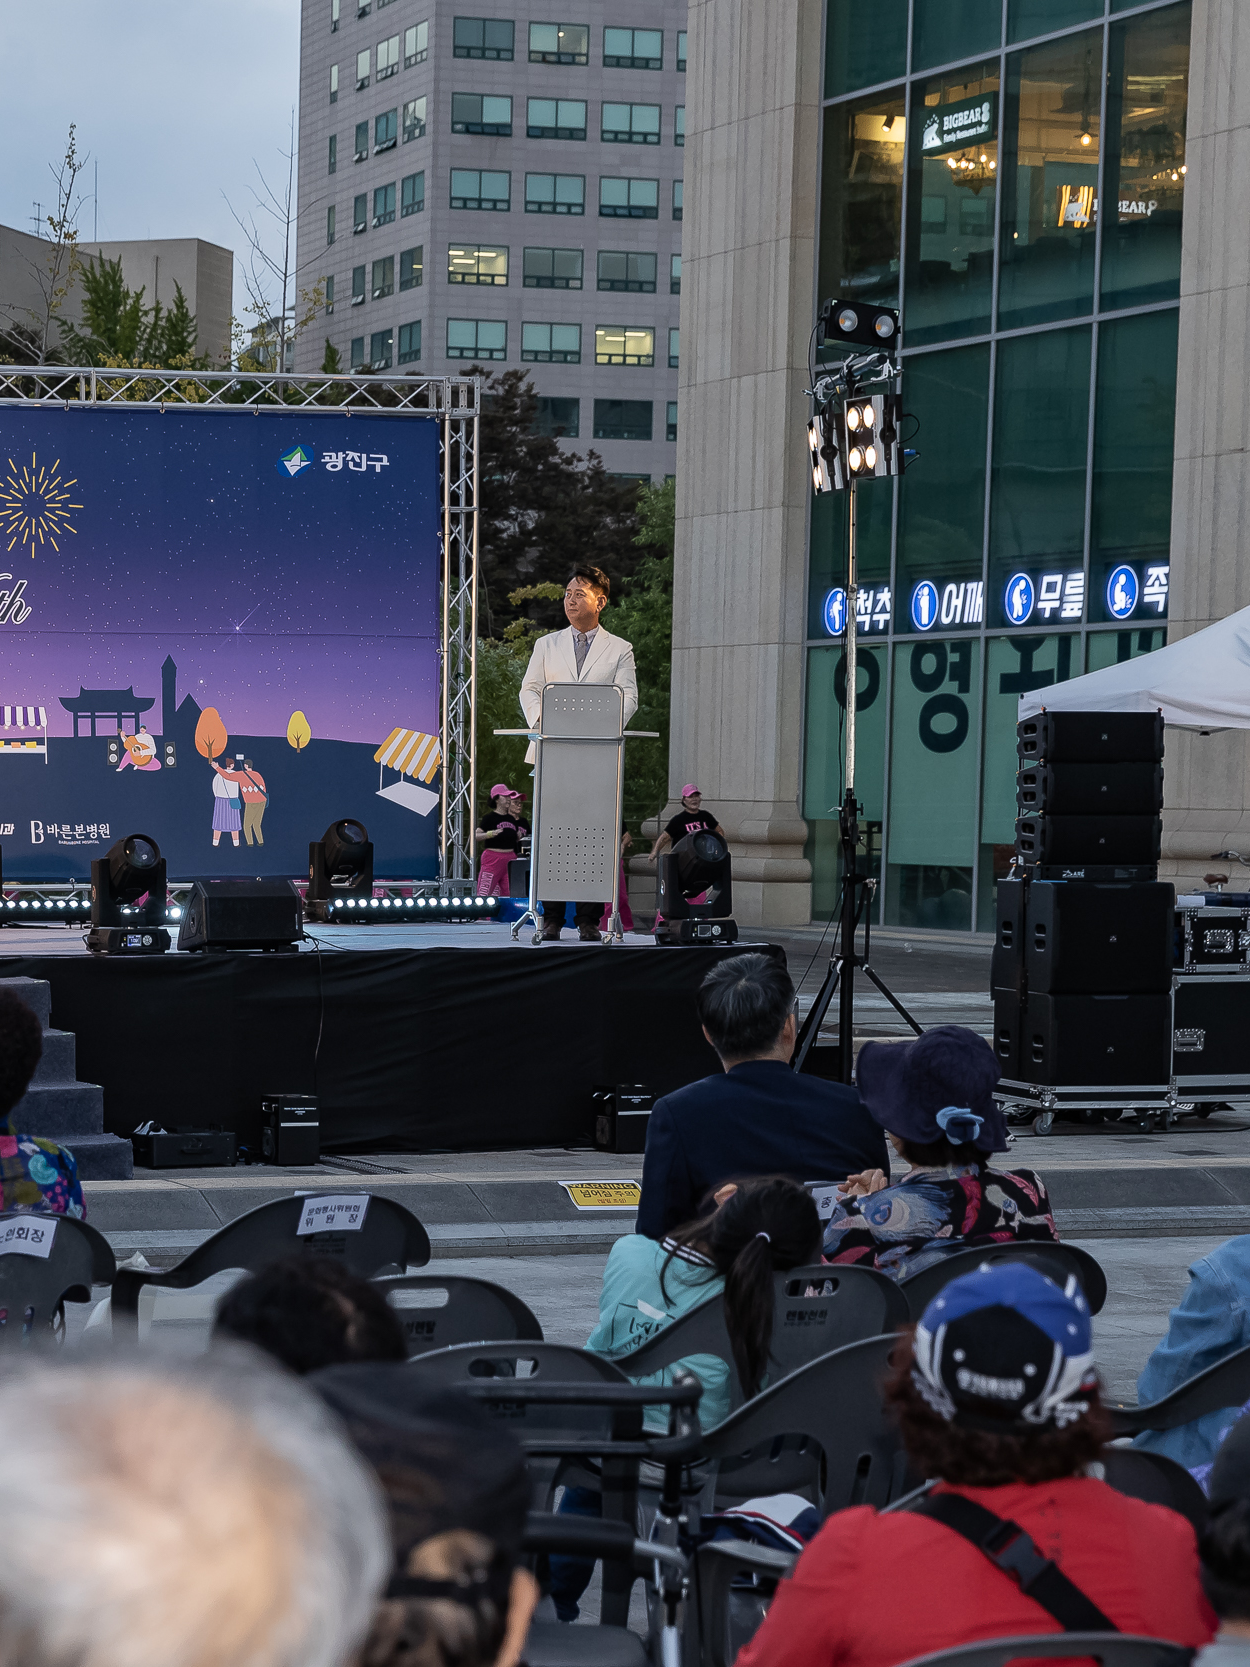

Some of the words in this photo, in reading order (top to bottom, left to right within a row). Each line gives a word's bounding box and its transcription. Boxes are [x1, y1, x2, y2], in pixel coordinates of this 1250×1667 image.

[321, 451, 390, 472] 광진구
[1037, 571, 1085, 618] 무릎
[47, 824, 110, 840] 바른본병원
[307, 1205, 360, 1216] 문화행사위원회
